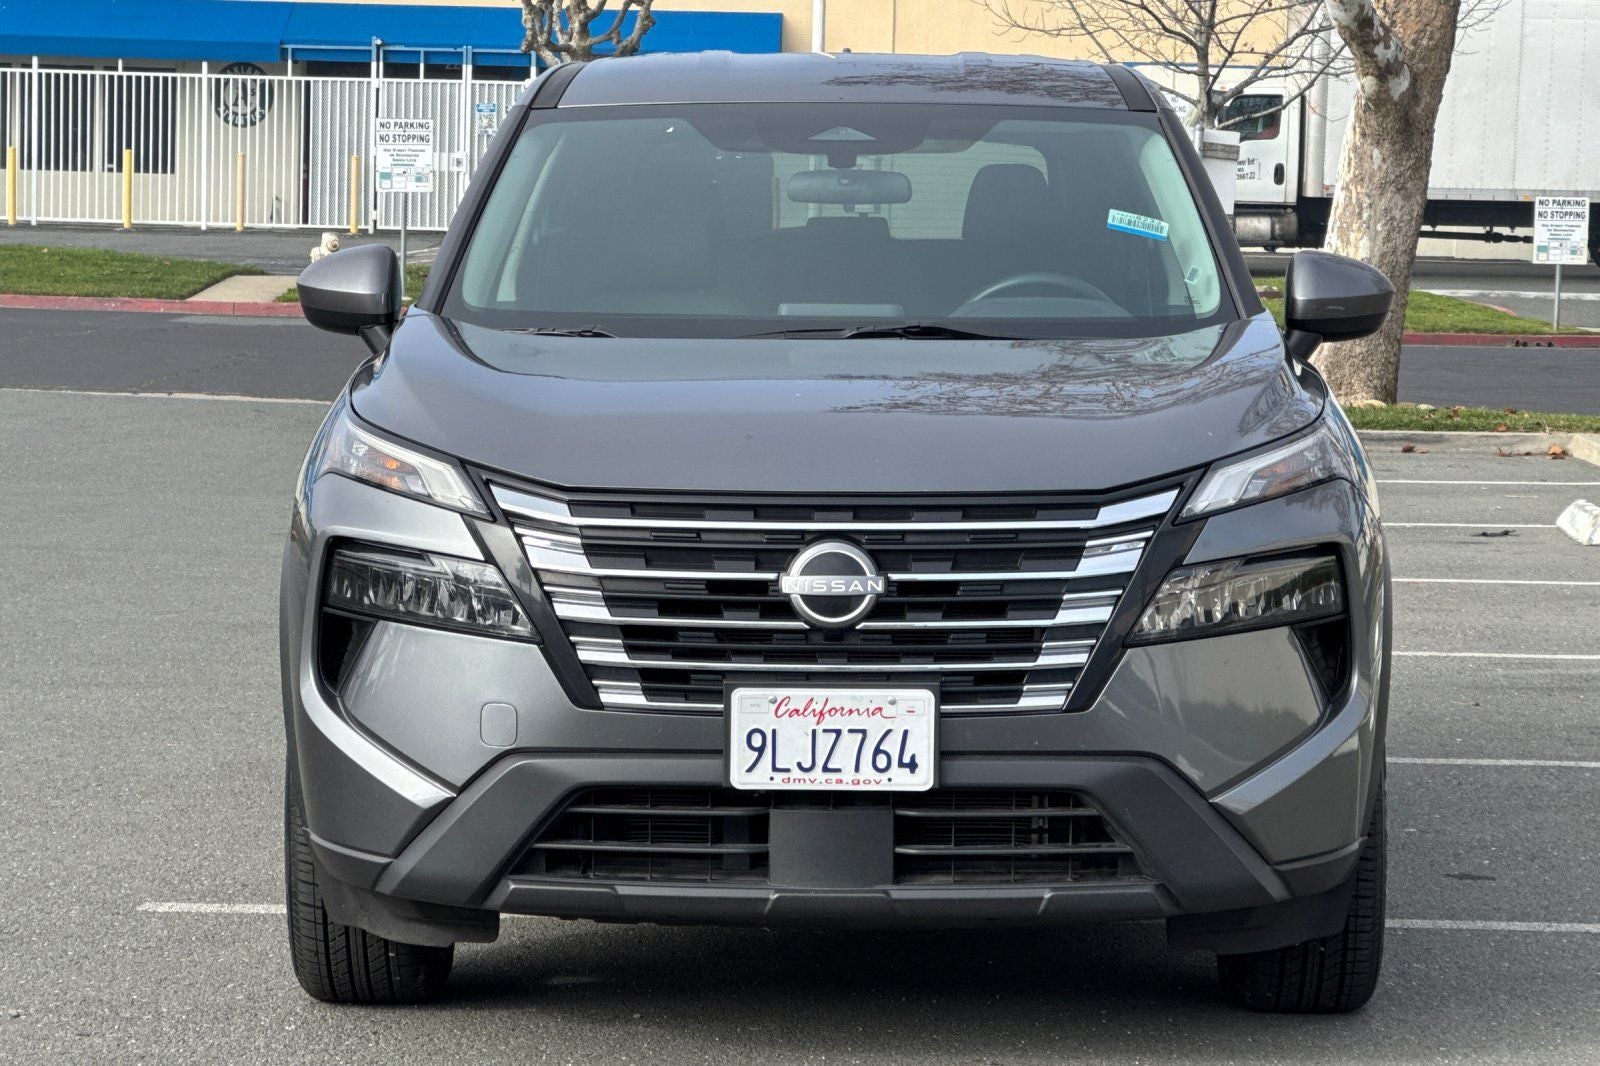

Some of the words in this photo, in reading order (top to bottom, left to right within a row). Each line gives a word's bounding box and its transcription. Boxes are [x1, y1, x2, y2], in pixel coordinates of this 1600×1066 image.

[379, 121, 391, 130] NO
[393, 121, 430, 130] PARKING
[379, 133, 390, 143] NO
[392, 133, 430, 143] STOPPING
[1538, 199, 1550, 207] NO
[1551, 199, 1587, 208] PARKING
[1537, 210, 1549, 219] NO
[1550, 210, 1586, 220] STOPPING
[785, 579, 883, 593] NISSAN
[774, 696, 897, 726] California
[745, 727, 919, 774] 9LJZ764
[781, 776, 883, 786] dmv.ca.gov
